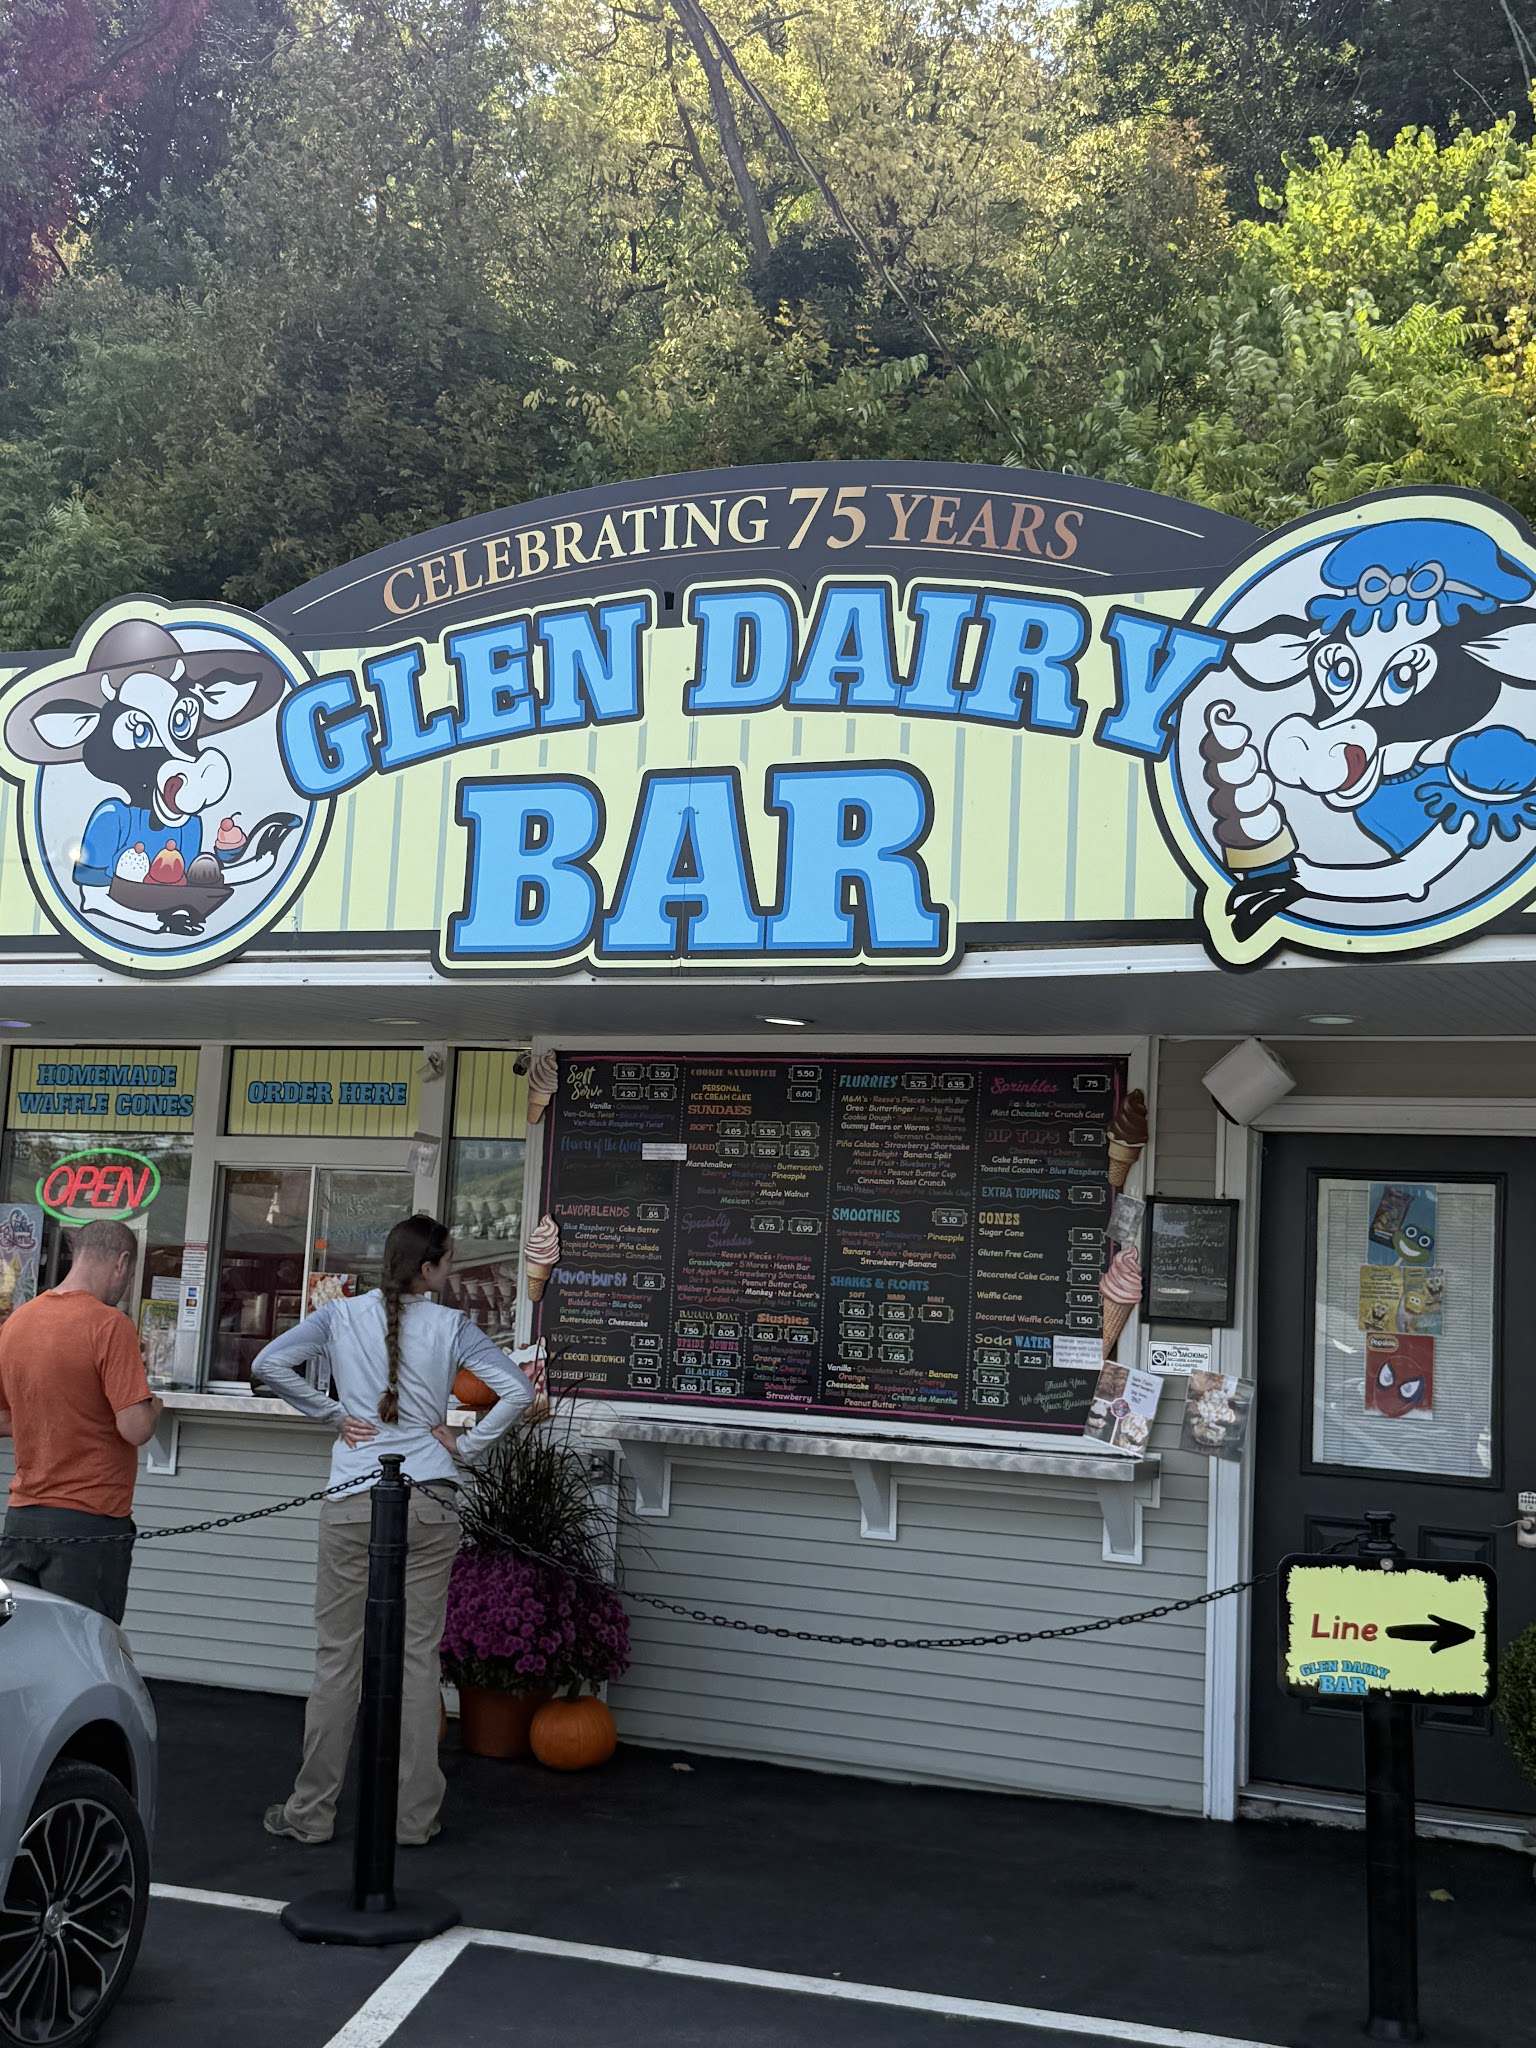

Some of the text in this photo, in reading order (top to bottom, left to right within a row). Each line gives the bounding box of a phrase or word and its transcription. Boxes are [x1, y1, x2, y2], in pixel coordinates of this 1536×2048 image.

[383, 485, 1086, 616] CELEBRATING 75 YEARS
[279, 582, 1230, 798] GLEN DAIRY
[448, 763, 946, 957] BAR
[37, 1064, 177, 1088] HOMEMADE
[566, 1064, 597, 1085] Soft
[702, 1084, 741, 1092] PERSONAL
[991, 1076, 1058, 1094] Sprinkles
[248, 1081, 407, 1106] ORDER HERE
[570, 1082, 603, 1101] Serve
[19, 1093, 193, 1117] WAFFLE CONES
[688, 1105, 752, 1116] SUNDAES
[868, 1104, 915, 1114] Butterfinger
[868, 1114, 892, 1122] Dough
[841, 1122, 868, 1132] Gummy
[854, 1140, 970, 1151] Colada Strawberry Shortcake
[934, 1152, 952, 1160] Split
[992, 1156, 1011, 1164] Cake
[686, 1160, 732, 1168] Marshmallow
[776, 1163, 824, 1172] Butterscotch
[1012, 1166, 1044, 1174] Coconut
[1049, 1166, 1066, 1175] Blue
[771, 1172, 806, 1181] Pineapple
[887, 1168, 957, 1180] Peanut Butter Cup
[43, 1164, 151, 1208] OPEN
[918, 1178, 946, 1186] Crunch
[760, 1190, 782, 1198] Maple
[982, 1186, 1012, 1198] EXTRA
[1014, 1188, 1060, 1200] TOPPINGS
[1080, 1191, 1093, 1200] .75
[555, 1204, 629, 1217] FLAVORBLENDS
[832, 1208, 900, 1223] SMOOTHIES
[681, 1213, 732, 1234] Specialty
[978, 1212, 1020, 1225] CONES
[579, 1224, 615, 1232] Raspberry
[978, 1228, 1024, 1238] Sugar Cone
[927, 1232, 964, 1243] Pineapple
[842, 1247, 871, 1255] Banana
[978, 1248, 1004, 1257] Gluten
[1023, 1250, 1044, 1259] Cone
[1079, 1252, 1094, 1260] .55
[688, 1258, 734, 1268] Grasshopper
[860, 1258, 937, 1269] Strawberry-Banana
[976, 1270, 1060, 1282] Decorated Cone
[1078, 1273, 1092, 1282] .90
[768, 1280, 791, 1288] Butter
[793, 1282, 808, 1290] Cup
[830, 1276, 930, 1292] SHAKES & FLOATS
[745, 1288, 773, 1298] Monkey
[976, 1292, 1022, 1300] Waffle Cone
[1076, 1294, 1094, 1302] 1.05
[560, 1316, 649, 1328] Butterscotch Cheesecake
[716, 1312, 739, 1321] BOAT
[757, 1312, 809, 1325] Slushies
[976, 1312, 1064, 1325] Decorated Waffle Cone
[1076, 1315, 1093, 1324] 1.50
[974, 1332, 1012, 1346] Soda
[1014, 1335, 1052, 1350] WATER
[752, 1354, 782, 1364] Orange
[983, 1356, 1002, 1364] 2.50
[1024, 1356, 1042, 1364] 2.25
[827, 1364, 958, 1380] Vanilla Coffee Banana
[838, 1372, 866, 1382] Orange
[826, 1380, 870, 1390] Cheesecake
[982, 1375, 1000, 1384] 2.75
[1044, 1380, 1068, 1393] Thank
[765, 1391, 812, 1404] Strawberry
[844, 1398, 896, 1408] Peanut Butter
[982, 1396, 1000, 1404] 3.00
[1018, 1390, 1074, 1406] We Appreciate
[1040, 1402, 1062, 1414] Your
[1311, 1614, 1378, 1641] Line
[1300, 1660, 1390, 1680] GLEN DAIRY
[1319, 1675, 1368, 1694] BAR
